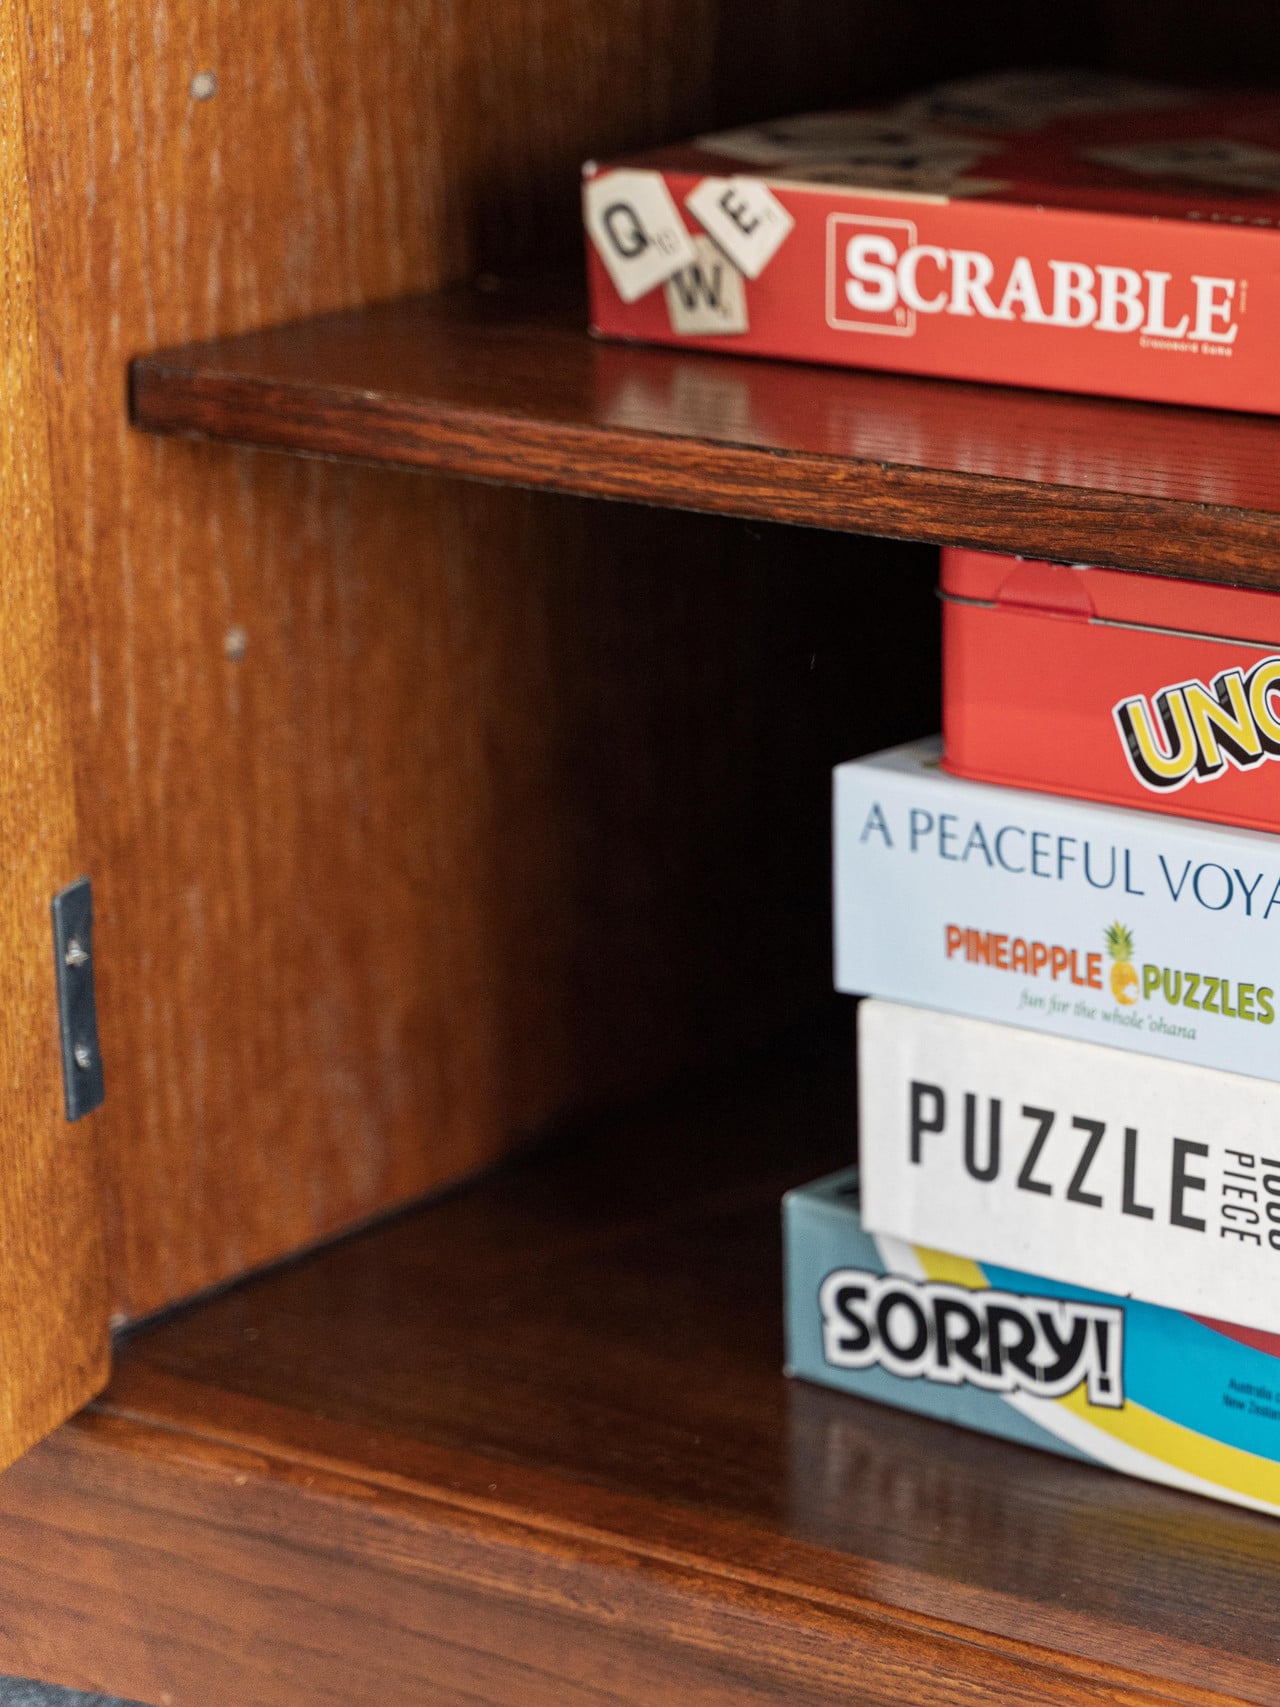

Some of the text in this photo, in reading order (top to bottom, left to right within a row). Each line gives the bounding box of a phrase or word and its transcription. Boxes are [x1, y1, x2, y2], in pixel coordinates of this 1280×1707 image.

[604, 203, 648, 259] Q
[720, 189, 759, 236] E
[671, 262, 722, 311] W
[845, 234, 1239, 344] SCRABBLE
[860, 802, 894, 847] A
[908, 808, 1146, 896] PEACEFUL
[945, 924, 1275, 1025] PINEAPPLE PUZZLES
[1016, 987, 1044, 1013] fun
[1047, 993, 1069, 1018] for
[1074, 999, 1096, 1019] the
[1100, 1005, 1143, 1028] whole
[910, 1080, 1209, 1232] PUZZLE
[1220, 1148, 1262, 1247] PIECE
[828, 1276, 1119, 1402] SORRY!
[1223, 1393, 1244, 1410] New
[1228, 1378, 1272, 1400] Australia
